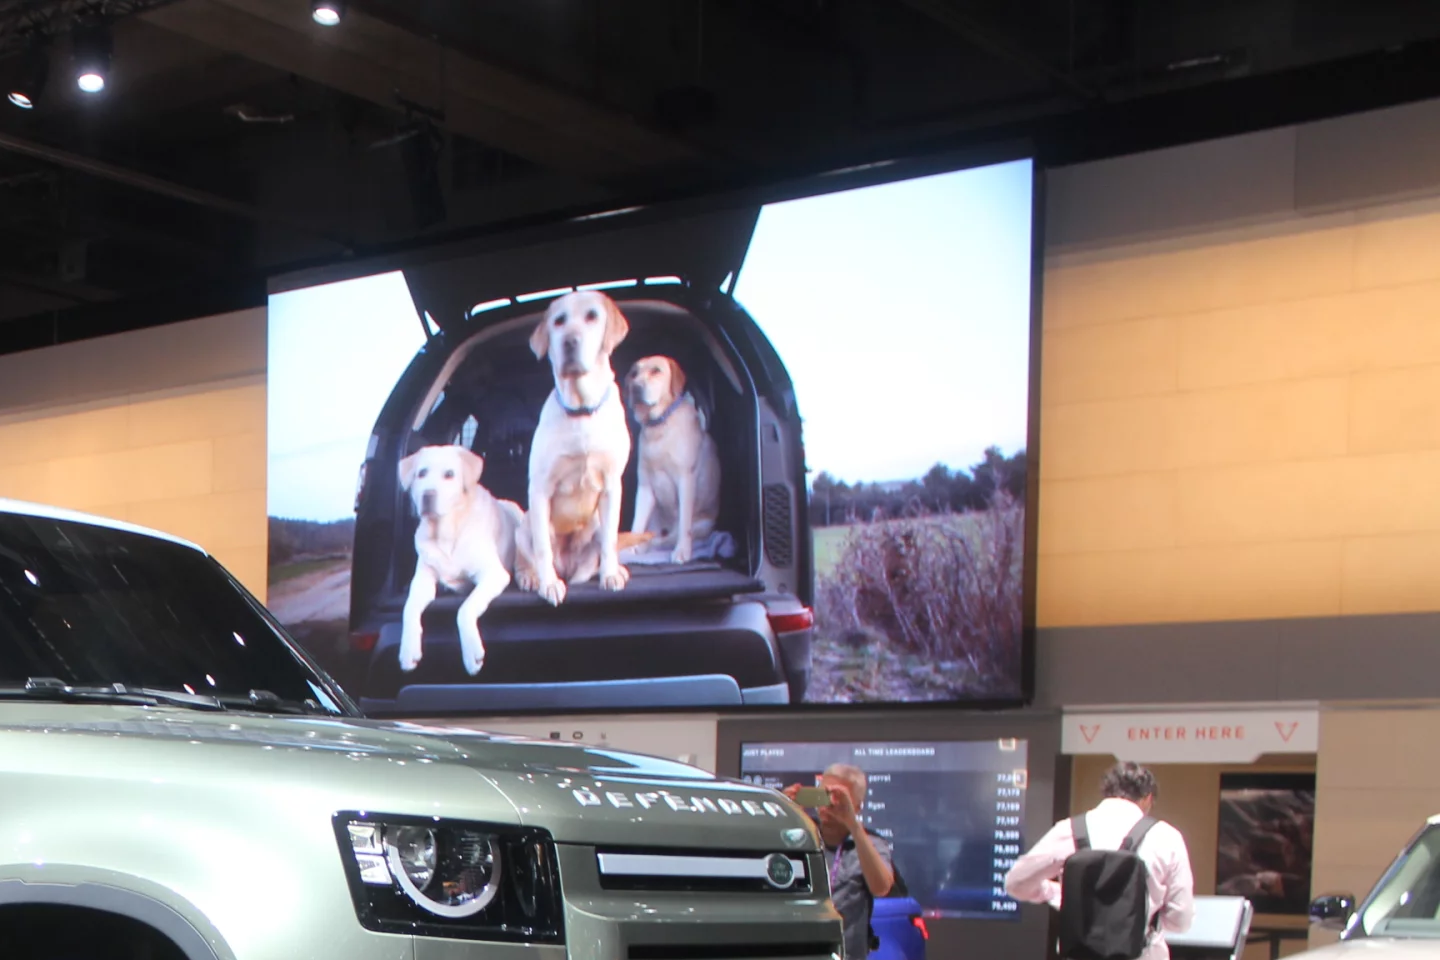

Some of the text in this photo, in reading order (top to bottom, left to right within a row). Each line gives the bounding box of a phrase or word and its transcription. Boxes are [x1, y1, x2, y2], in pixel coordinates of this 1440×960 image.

[1127, 725, 1245, 741] ENTER HERE
[854, 747, 936, 756] ALL TIME LEADERBOARD
[572, 788, 788, 817] DEFENDER
